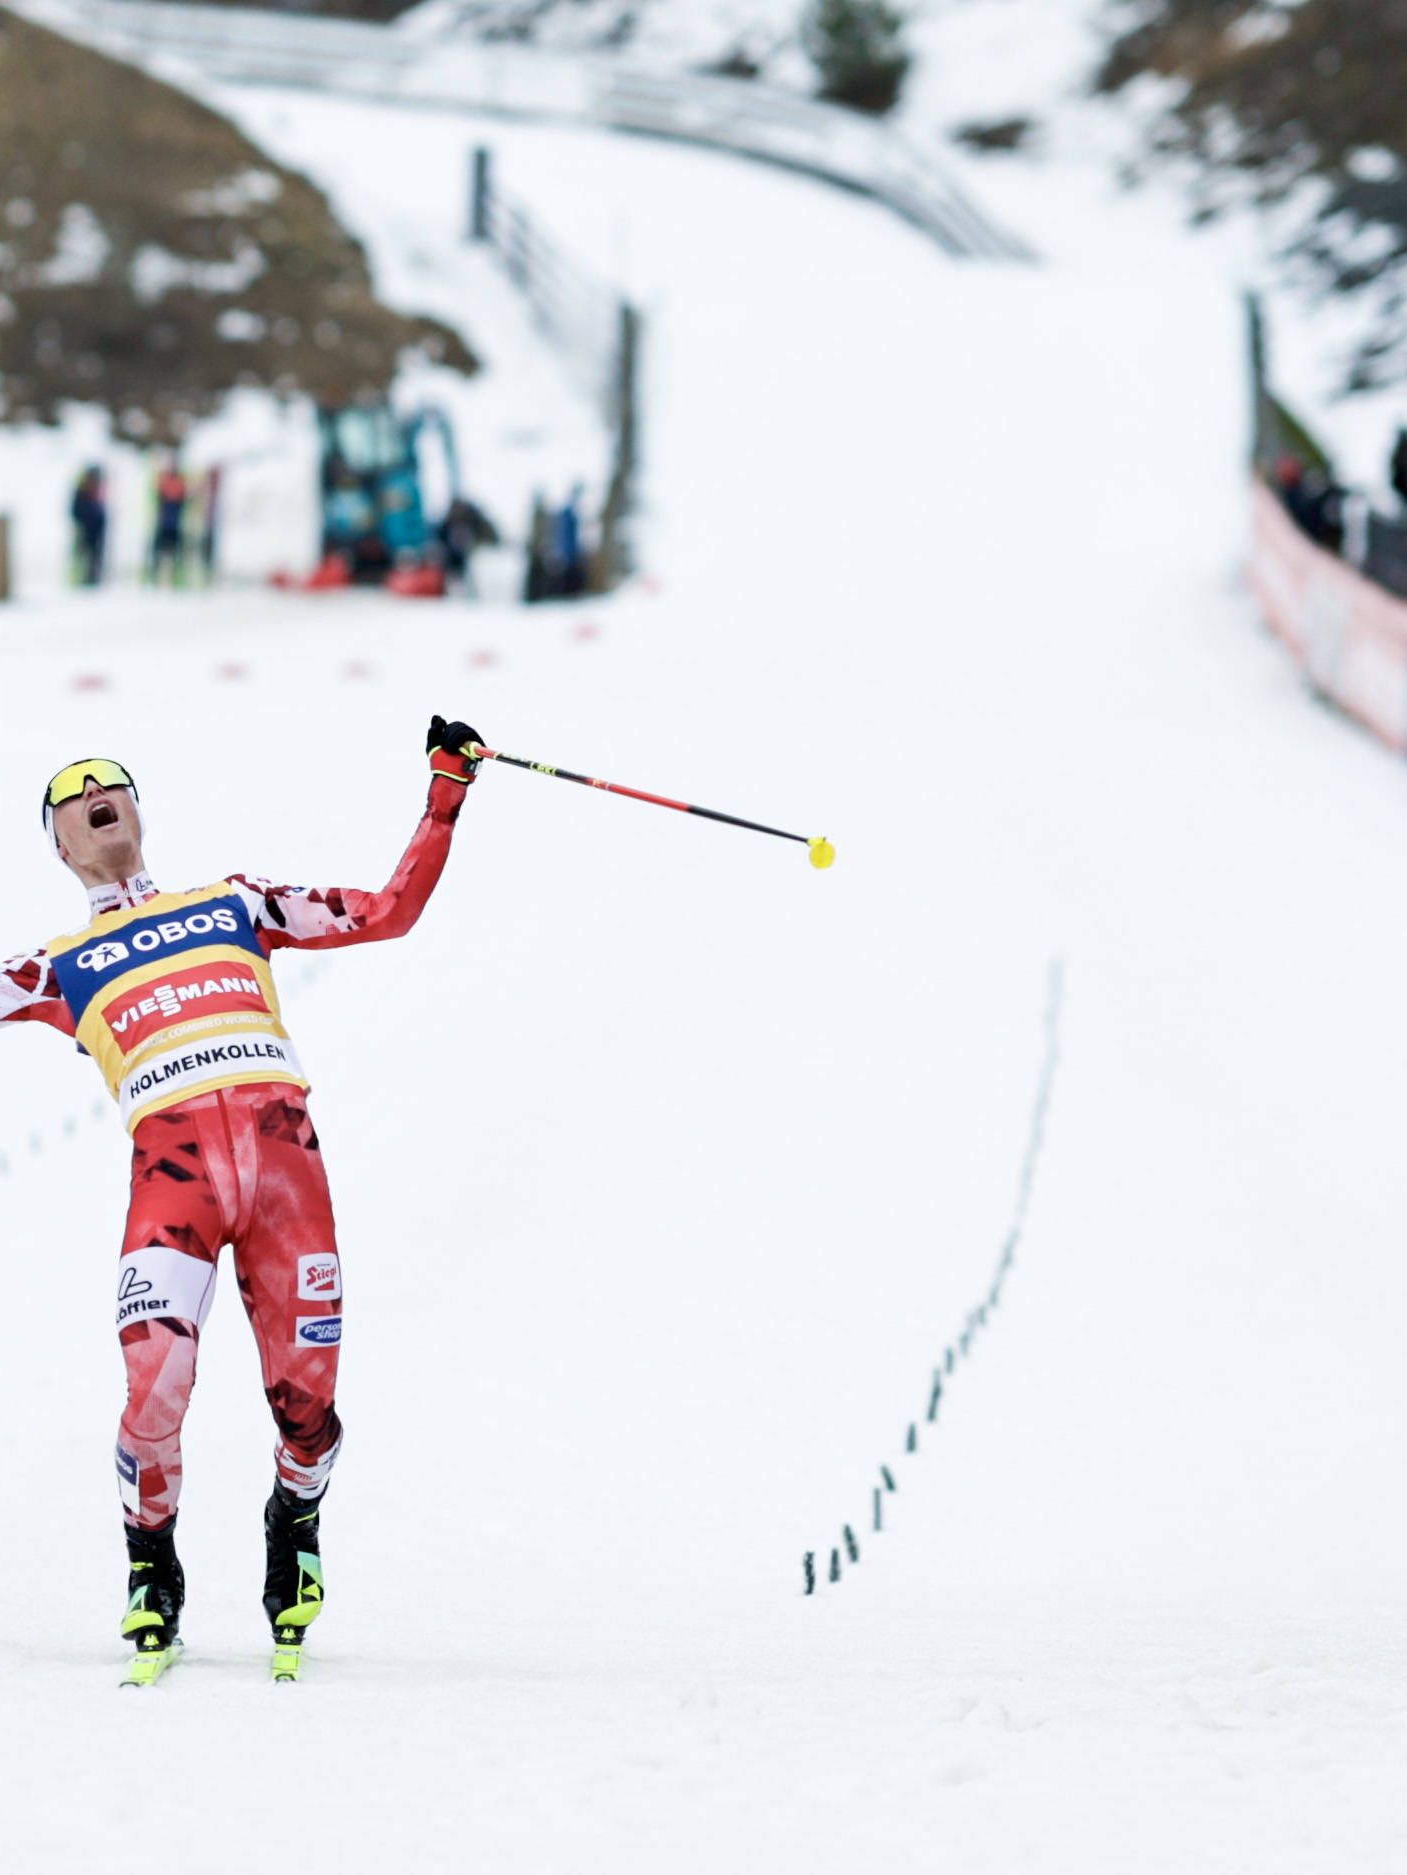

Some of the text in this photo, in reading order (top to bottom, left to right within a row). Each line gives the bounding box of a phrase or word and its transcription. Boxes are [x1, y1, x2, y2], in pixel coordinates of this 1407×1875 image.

[131, 908, 238, 951] OBOS
[110, 976, 261, 1034] VIESSMANN
[129, 1043, 286, 1099] HOLMENKOLLEN
